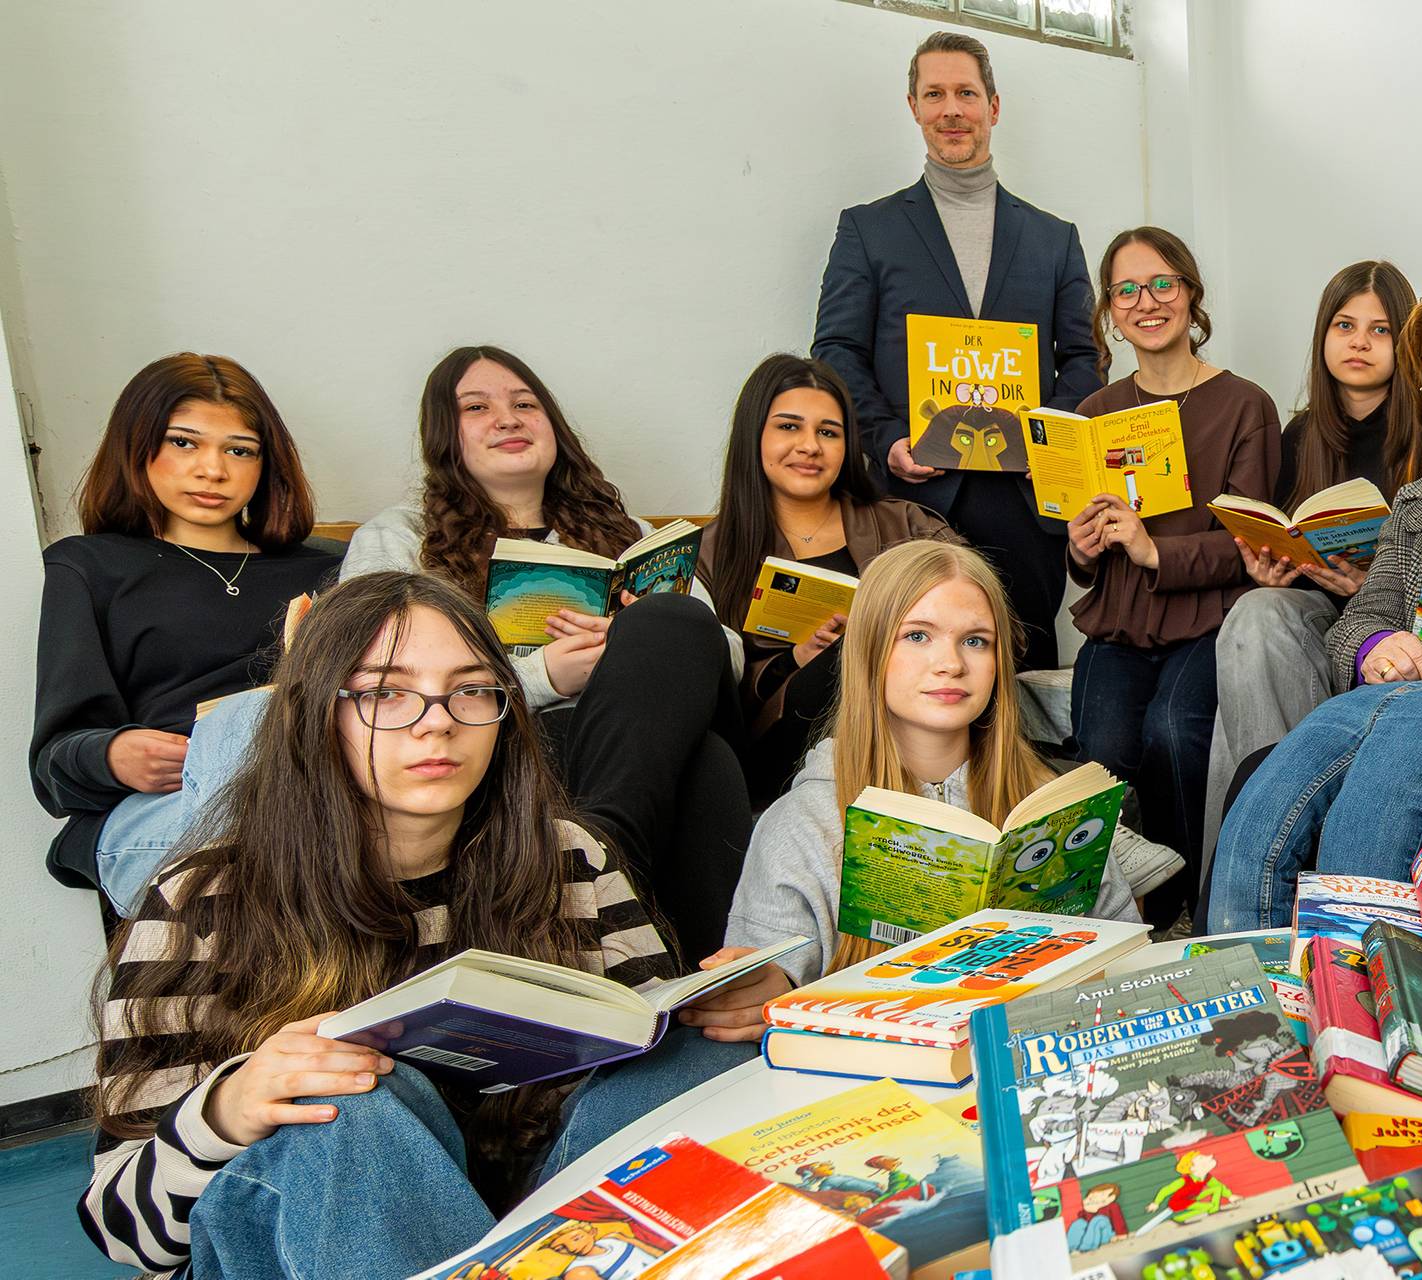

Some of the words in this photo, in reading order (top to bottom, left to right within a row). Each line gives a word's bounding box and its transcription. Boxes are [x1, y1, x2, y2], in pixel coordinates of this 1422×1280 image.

[964, 335, 983, 346] DER
[925, 341, 1022, 380] LÖWE
[931, 378, 951, 396] IN
[1001, 383, 1025, 401] DIR
[1104, 416, 1128, 428] ERICH
[1111, 435, 1126, 444] und
[1125, 433, 1137, 441] die
[1137, 426, 1171, 439] Detektive
[1130, 421, 1150, 433] Emil
[1075, 985, 1115, 1004] Anu
[1119, 966, 1194, 993] Stohner
[1140, 1013, 1165, 1026] UND
[1165, 989, 1262, 1027] RITTER
[1145, 1021, 1165, 1032] DIE
[1082, 1046, 1116, 1062] DAS
[1124, 1023, 1202, 1051] TURNIER
[1108, 1054, 1128, 1067] Mit
[1130, 1038, 1199, 1060] Illustrationen
[1117, 1062, 1136, 1072] von
[1137, 1054, 1161, 1070] Jörg
[1162, 1046, 1196, 1061] Mühle
[744, 1115, 873, 1169] Geheimnis
[876, 1100, 913, 1119] der
[752, 1125, 775, 1138] dtv
[776, 1111, 813, 1132] junior
[777, 1115, 841, 1142] Ibbotson
[866, 1110, 924, 1133] Insel
[619, 1151, 668, 1185] Schroedel
[1295, 1178, 1340, 1203] dtv
